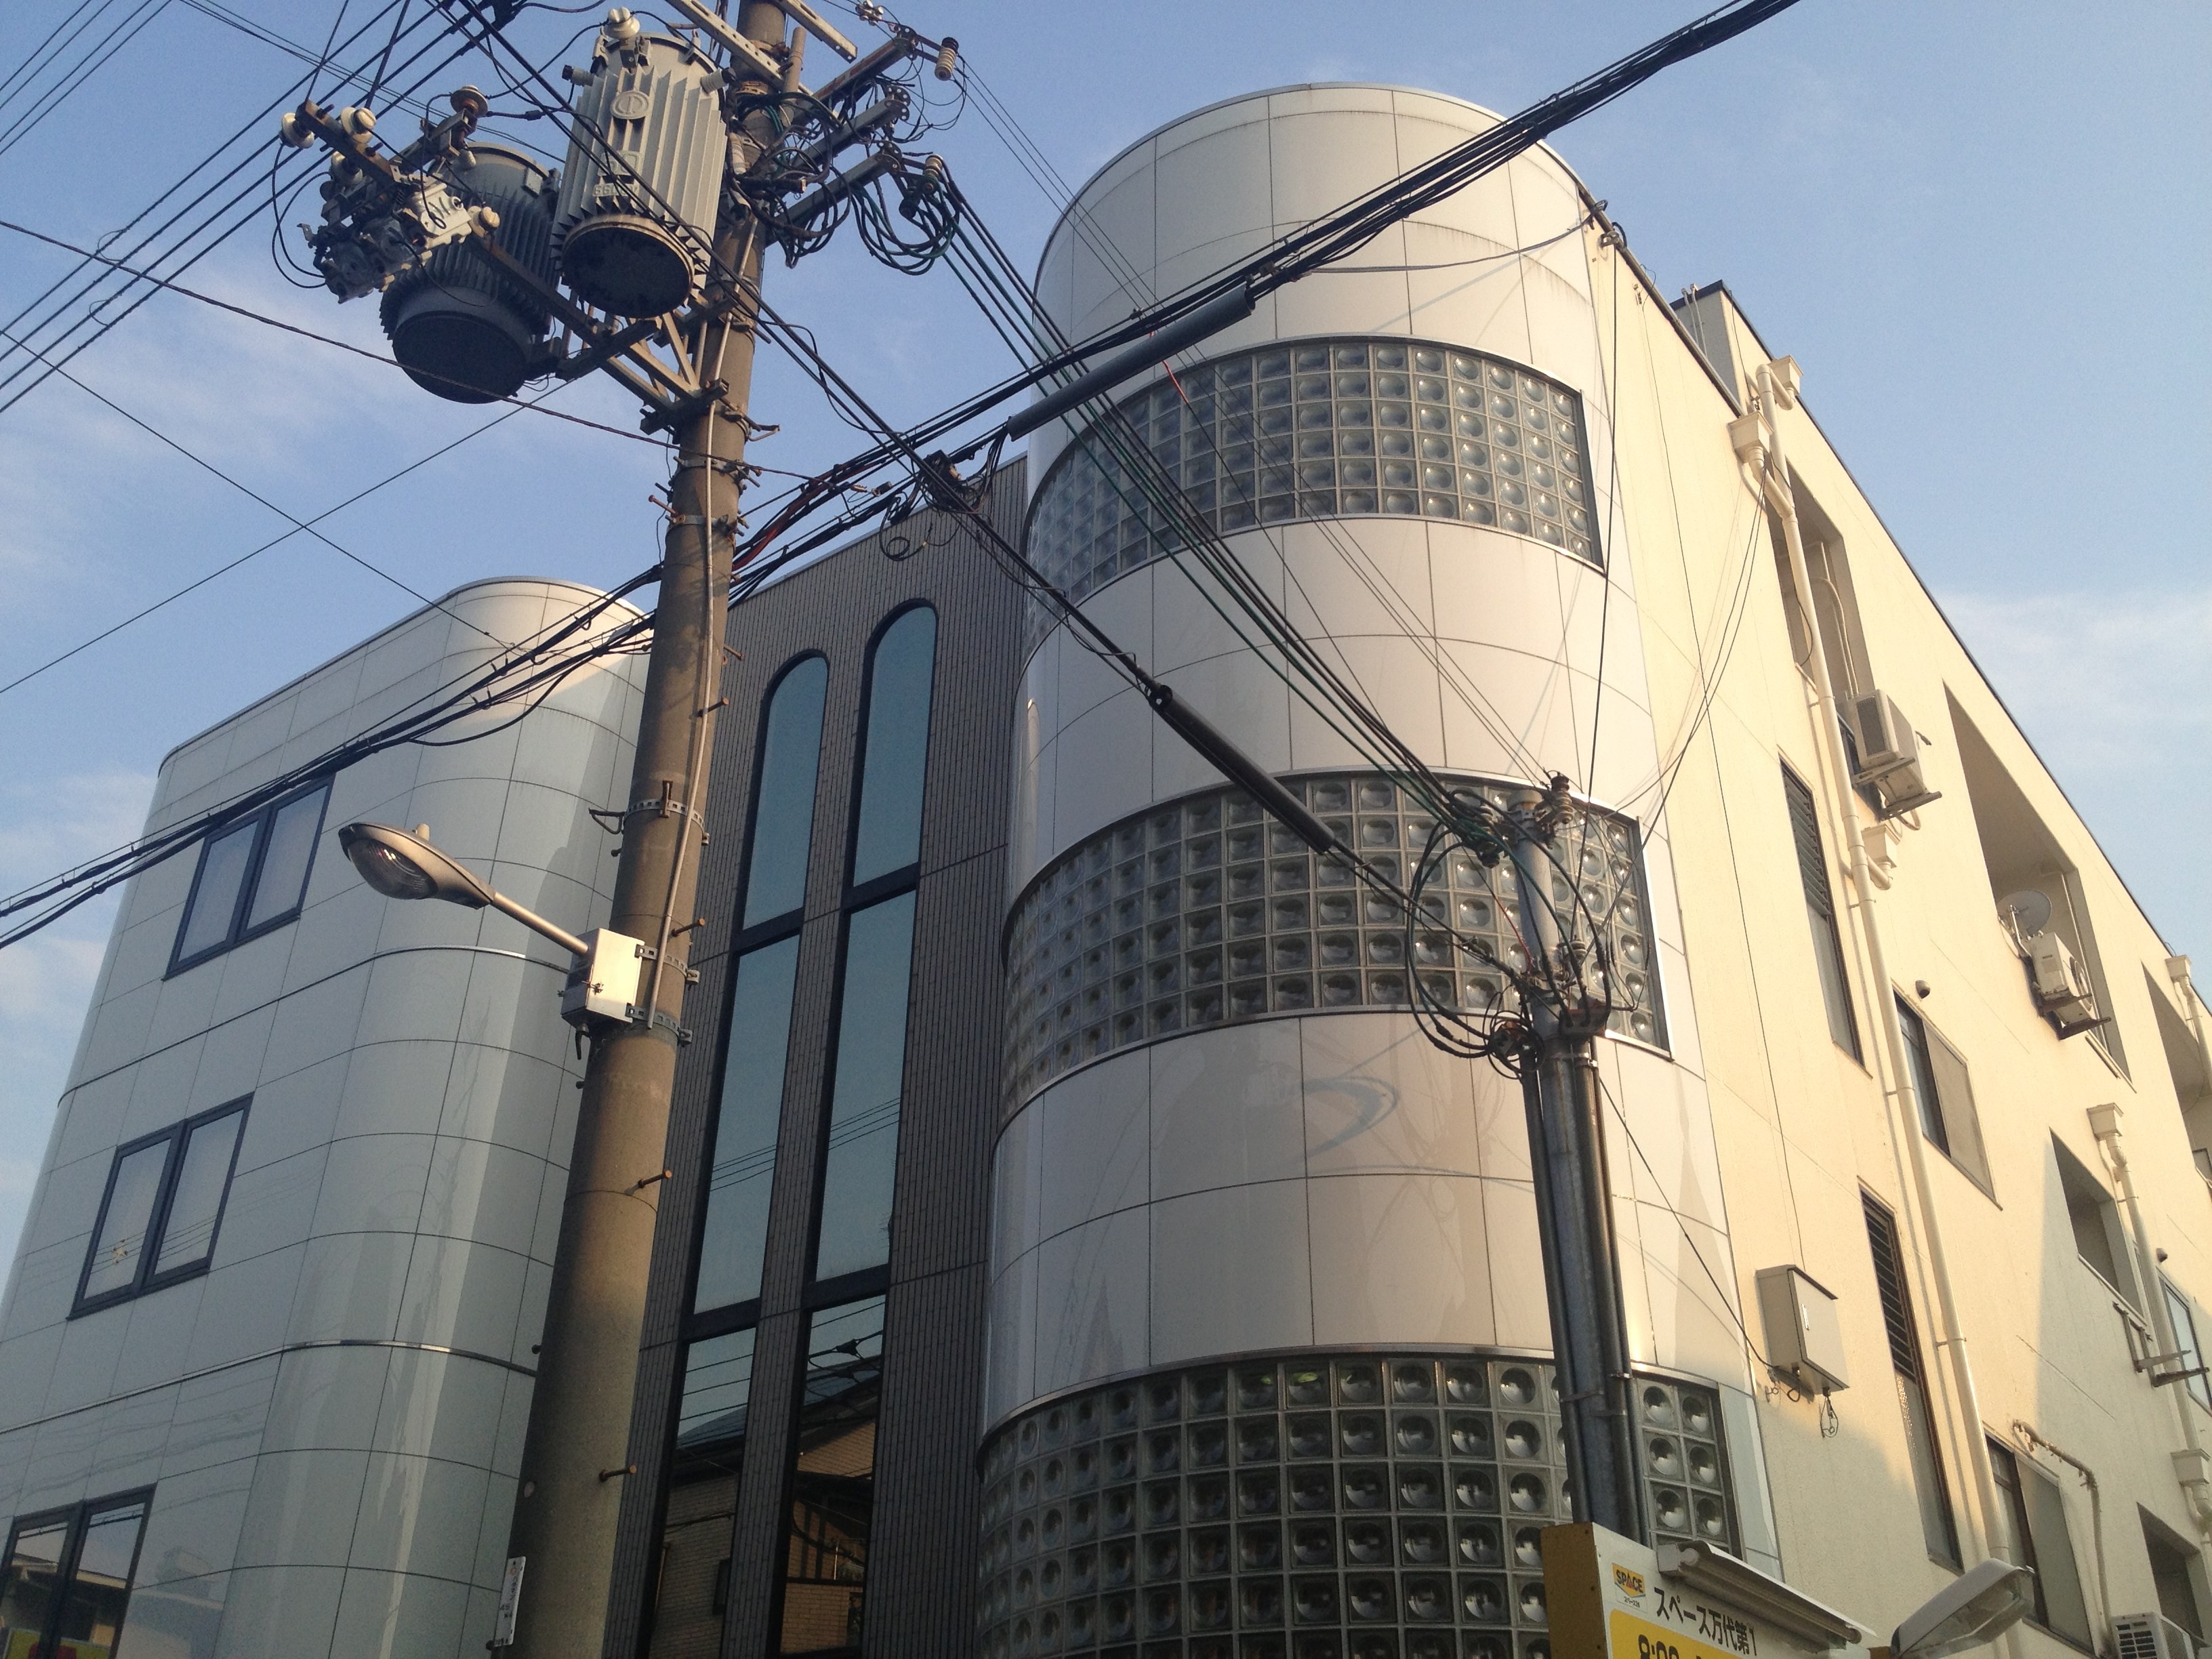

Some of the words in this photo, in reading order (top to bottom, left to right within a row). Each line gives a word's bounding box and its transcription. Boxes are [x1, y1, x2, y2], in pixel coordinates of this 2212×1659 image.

[1616, 1570, 1643, 1593] SPACE
[1654, 1587, 1757, 1656] スペース万代第1
